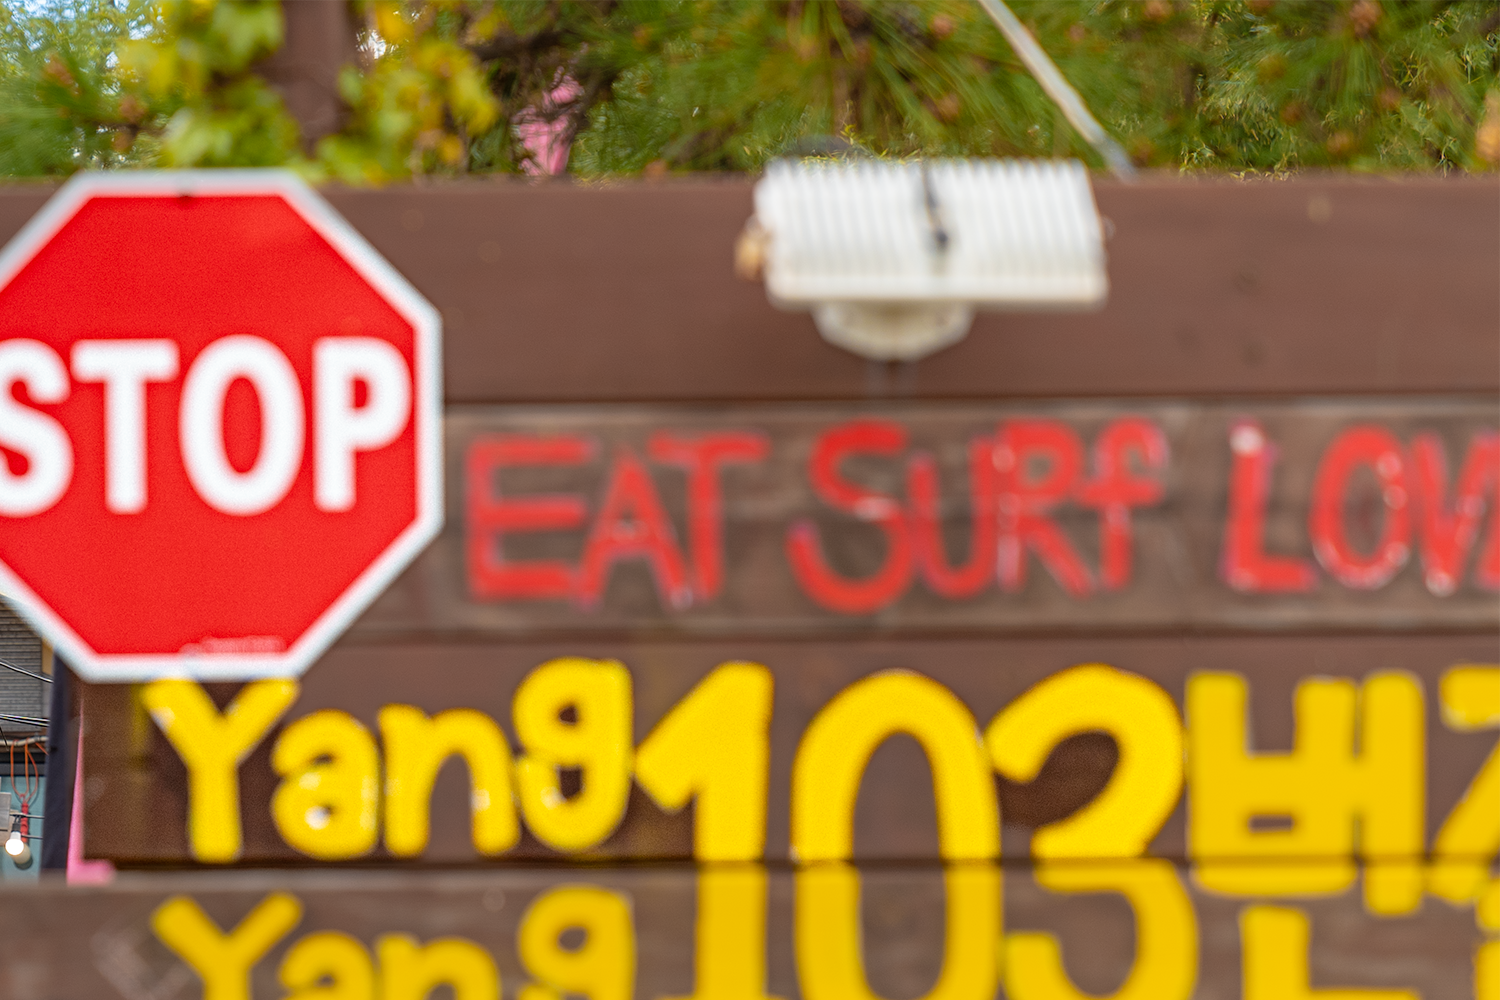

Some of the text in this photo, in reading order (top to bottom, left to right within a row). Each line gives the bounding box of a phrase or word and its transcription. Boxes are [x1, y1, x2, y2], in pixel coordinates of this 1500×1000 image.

[465, 432, 769, 608] EAT
[1225, 417, 1500, 598] LOV
[143, 657, 632, 862] Yang
